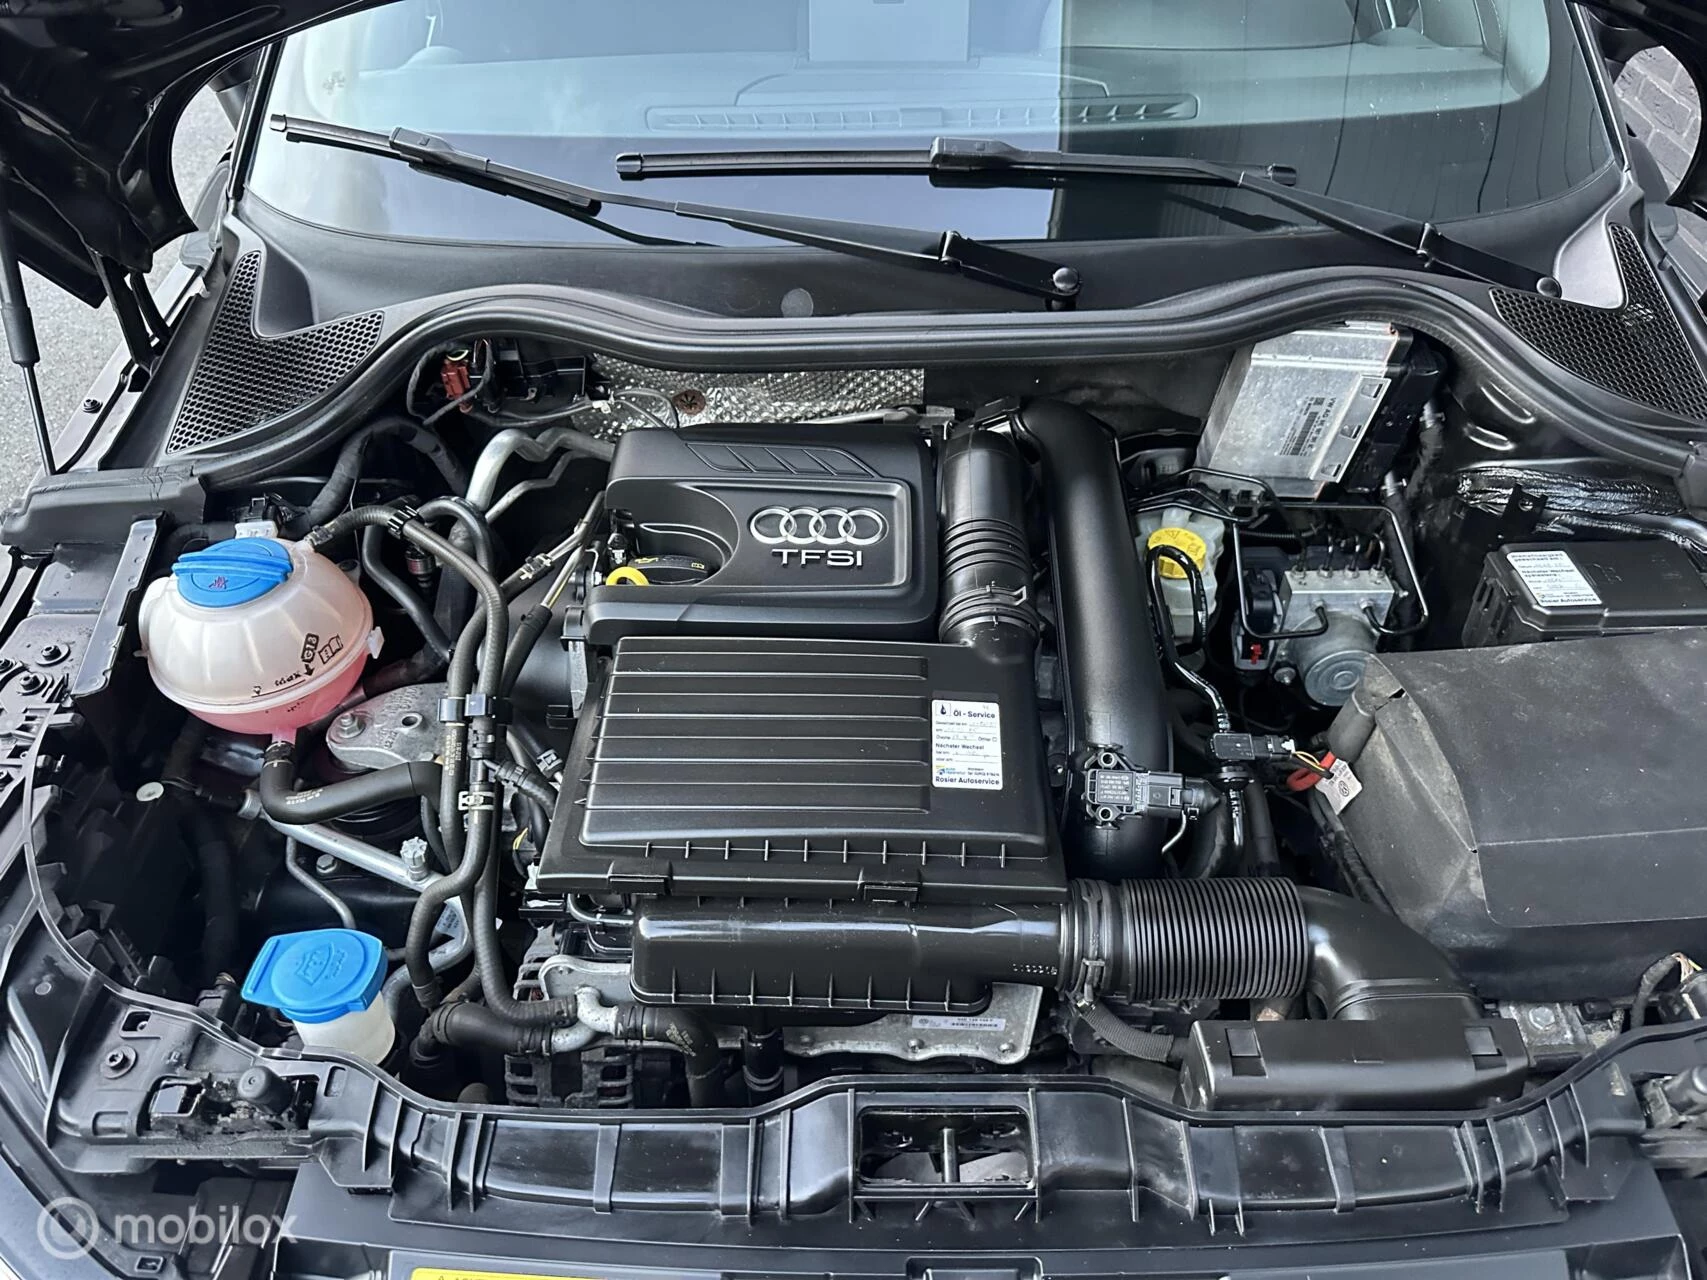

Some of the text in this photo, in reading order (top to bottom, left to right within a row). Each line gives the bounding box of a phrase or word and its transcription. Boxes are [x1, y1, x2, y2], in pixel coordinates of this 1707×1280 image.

[771, 549, 863, 567] TFSI
[967, 711, 996, 719] Service
[935, 775, 1000, 785] Rosier Autoservice
